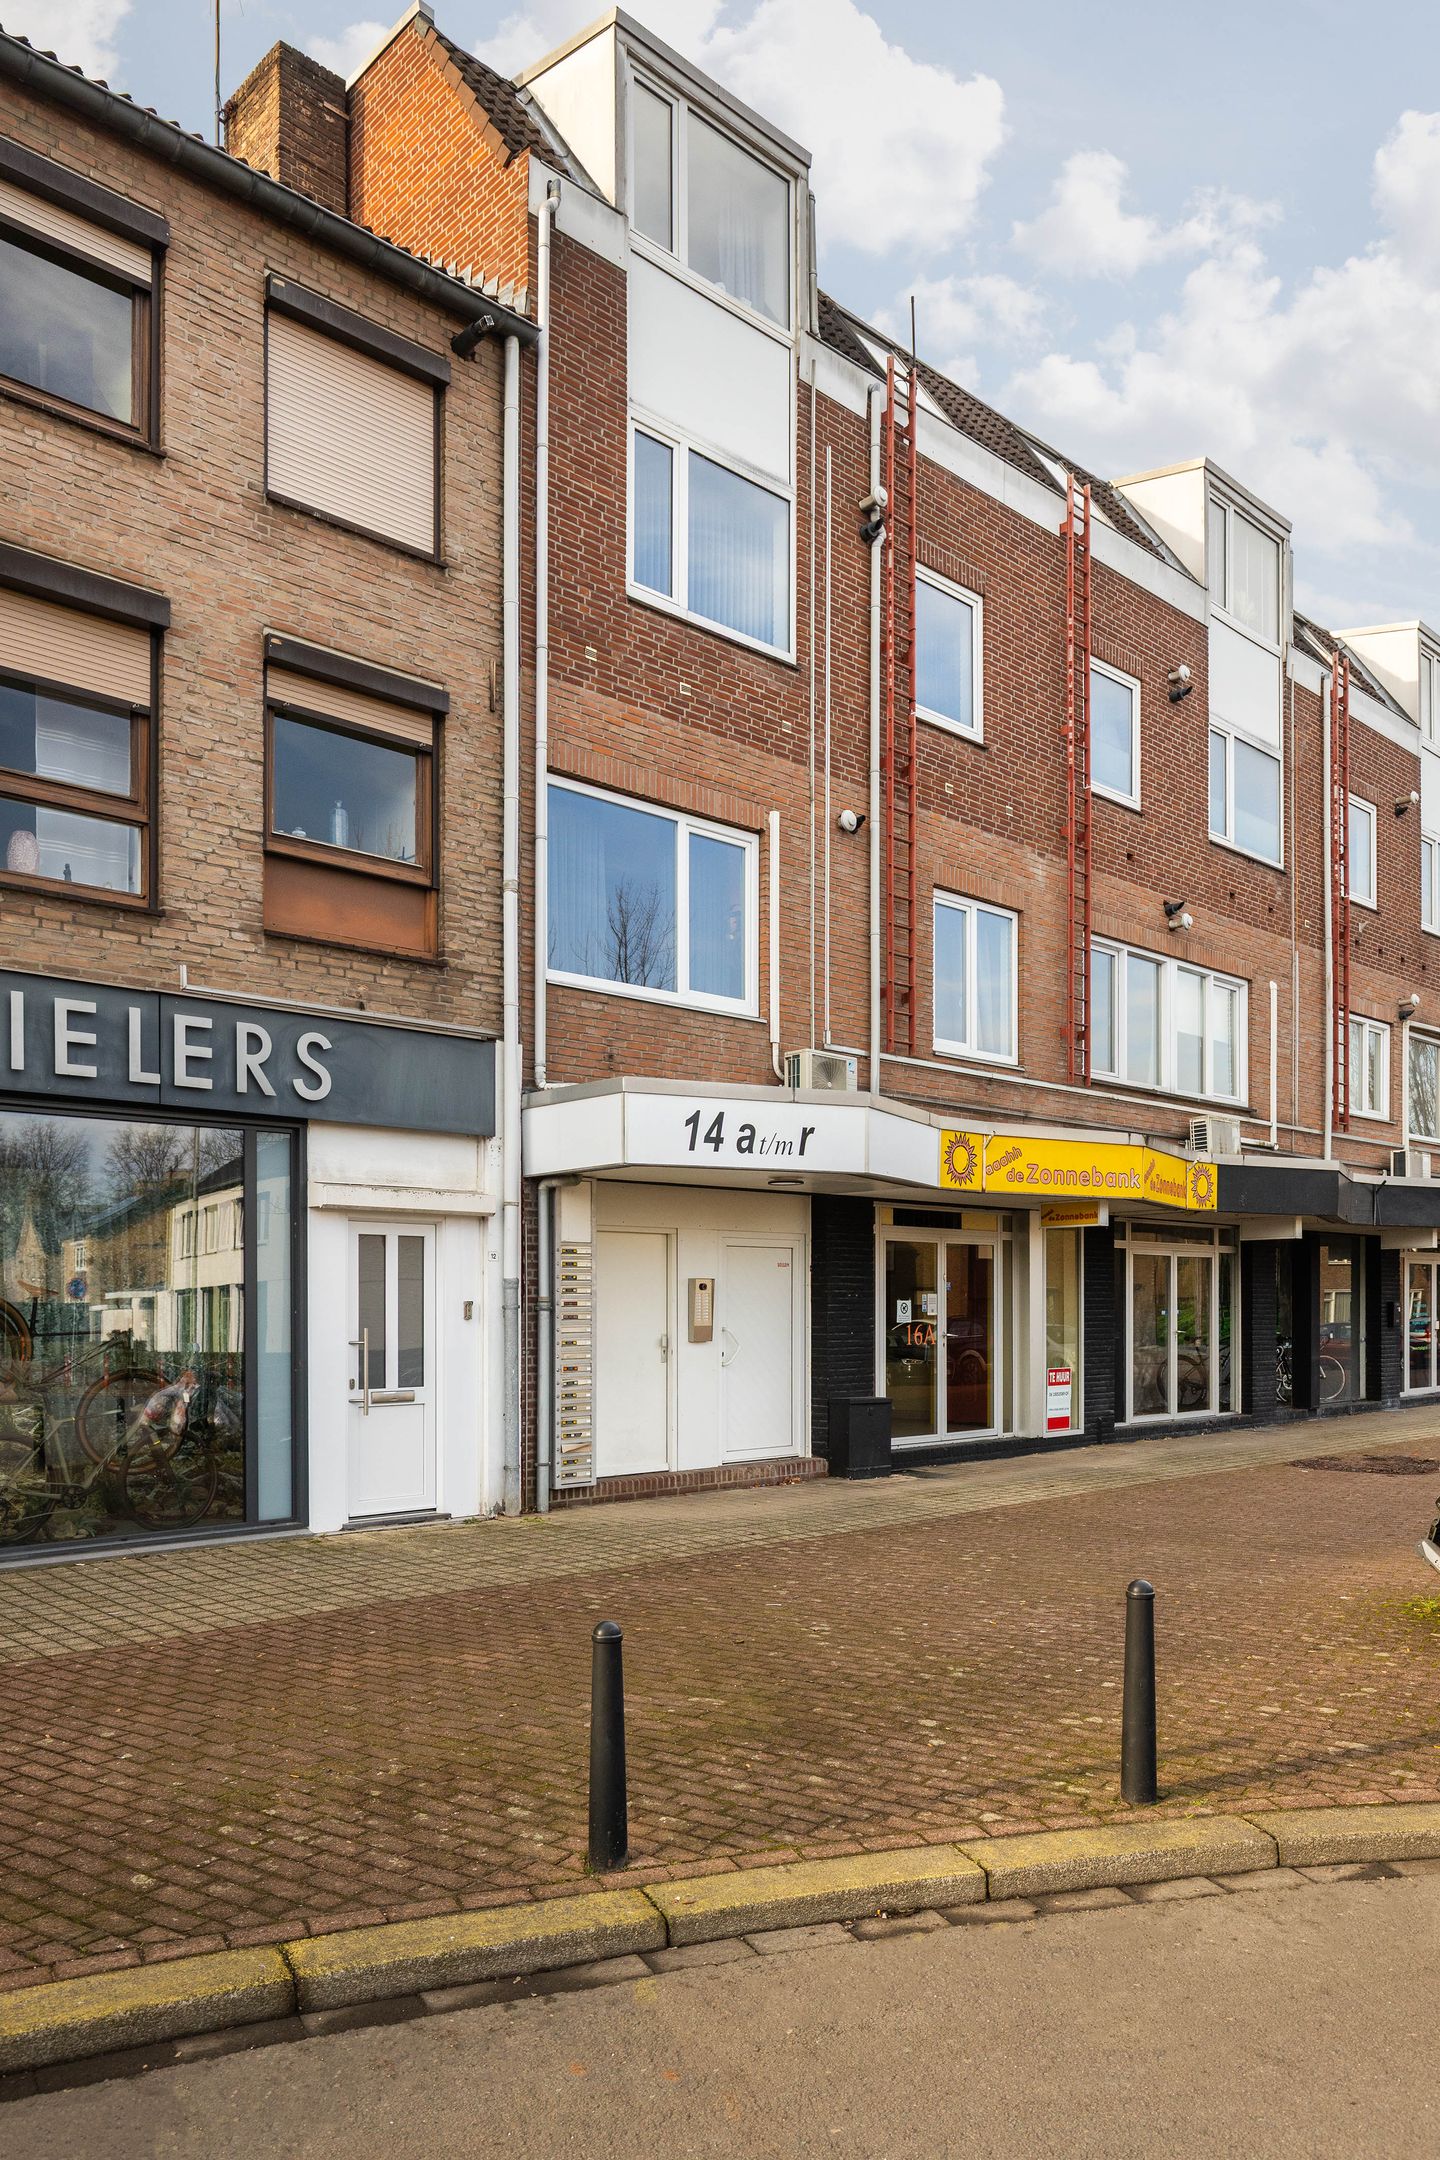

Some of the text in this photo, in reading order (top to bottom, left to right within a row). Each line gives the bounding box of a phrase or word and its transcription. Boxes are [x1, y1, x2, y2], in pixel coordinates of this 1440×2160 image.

[10, 990, 333, 1101] IELERS
[684, 1109, 816, 1156] 14 a t/m r
[986, 1146, 1023, 1175] aaahh
[1006, 1168, 1024, 1182] de
[1026, 1163, 1141, 1189] Zonnebank
[1055, 1211, 1098, 1221] Zonnebank
[906, 1324, 936, 1346] 16A
[1049, 1371, 1056, 1383] TE
